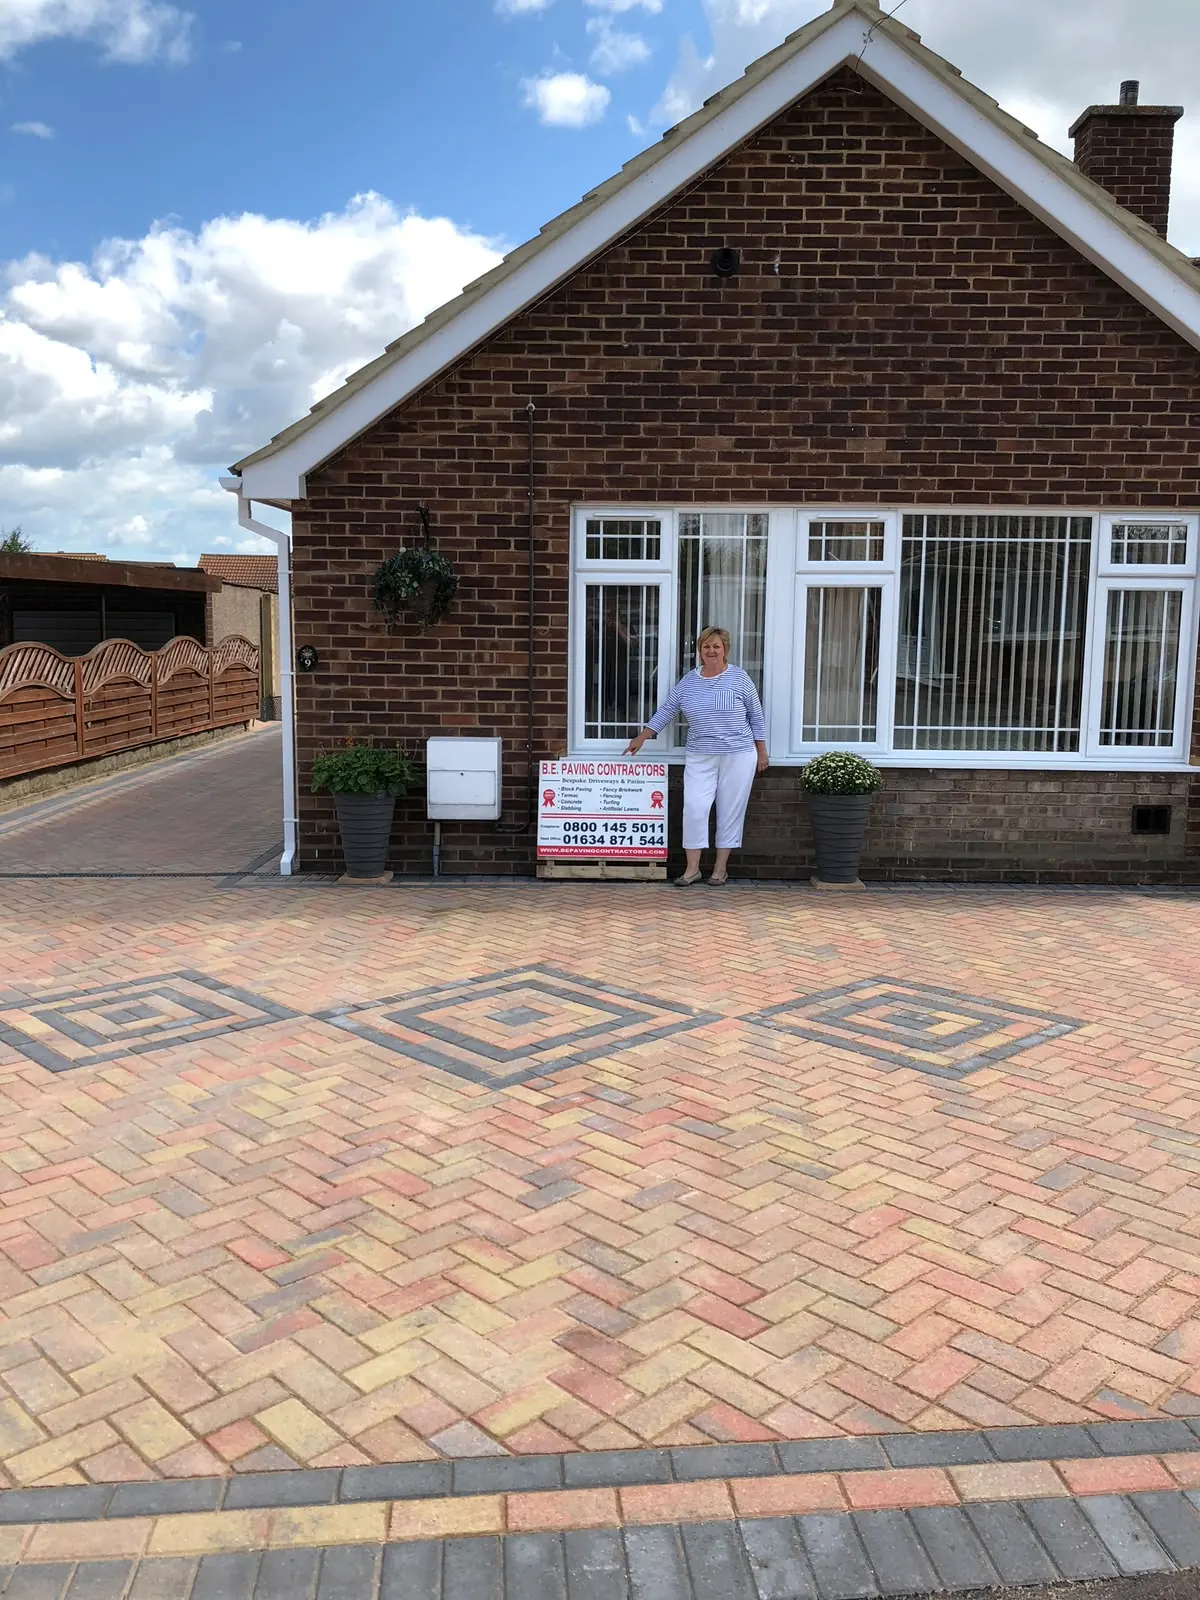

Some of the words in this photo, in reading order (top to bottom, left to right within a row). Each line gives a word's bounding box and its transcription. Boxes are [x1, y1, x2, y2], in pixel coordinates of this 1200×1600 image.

[304, 659, 311, 668] 9
[542, 763, 559, 775] B.E.
[561, 763, 594, 776] PAVING
[597, 763, 665, 777] CONTRACTORS
[563, 821, 597, 833] 0800
[602, 822, 627, 833] 145
[631, 823, 664, 834] 5011
[563, 834, 605, 845] 01634
[609, 835, 634, 846] 871
[639, 835, 665, 847] 544
[540, 847, 665, 855] WWW.BEPAVINGCONTRACTORS.COM
